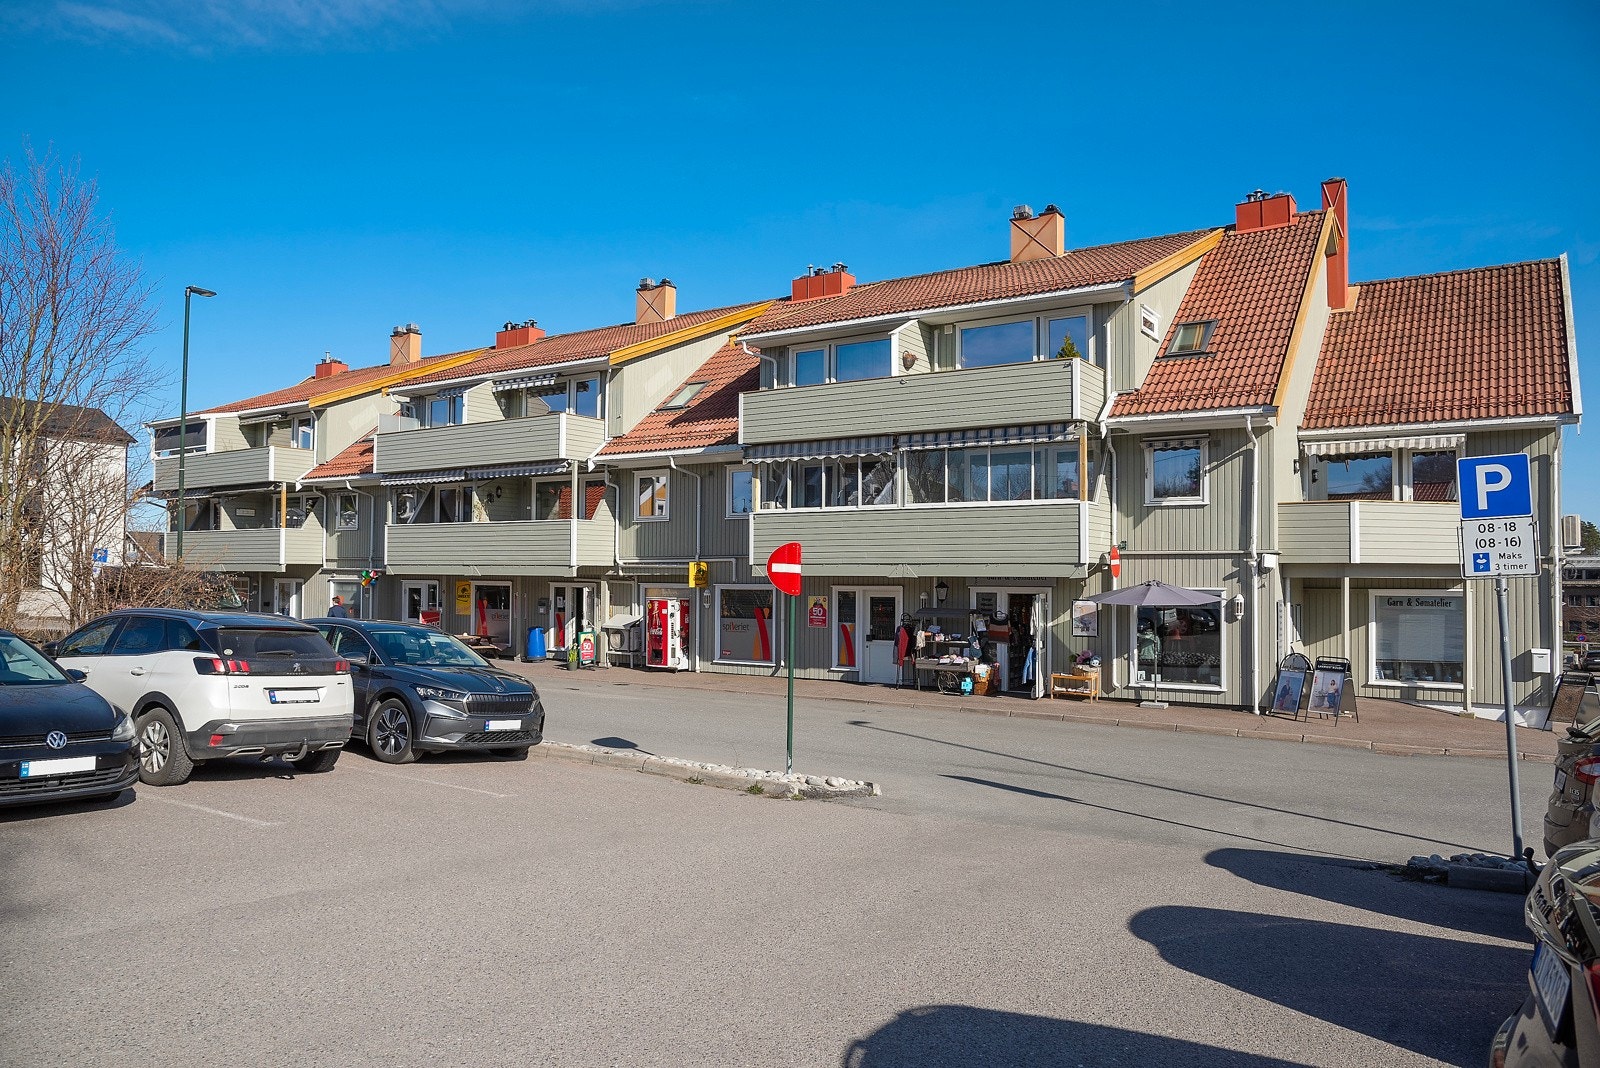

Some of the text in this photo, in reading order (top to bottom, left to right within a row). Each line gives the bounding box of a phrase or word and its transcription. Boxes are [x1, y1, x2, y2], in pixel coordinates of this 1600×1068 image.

[1475, 464, 1512, 510] P
[1498, 552, 1522, 560] Maks
[1495, 562, 1528, 571] 3 timer
[1387, 597, 1403, 606] Garn
[1406, 597, 1413, 606] &
[812, 607, 823, 616] 50
